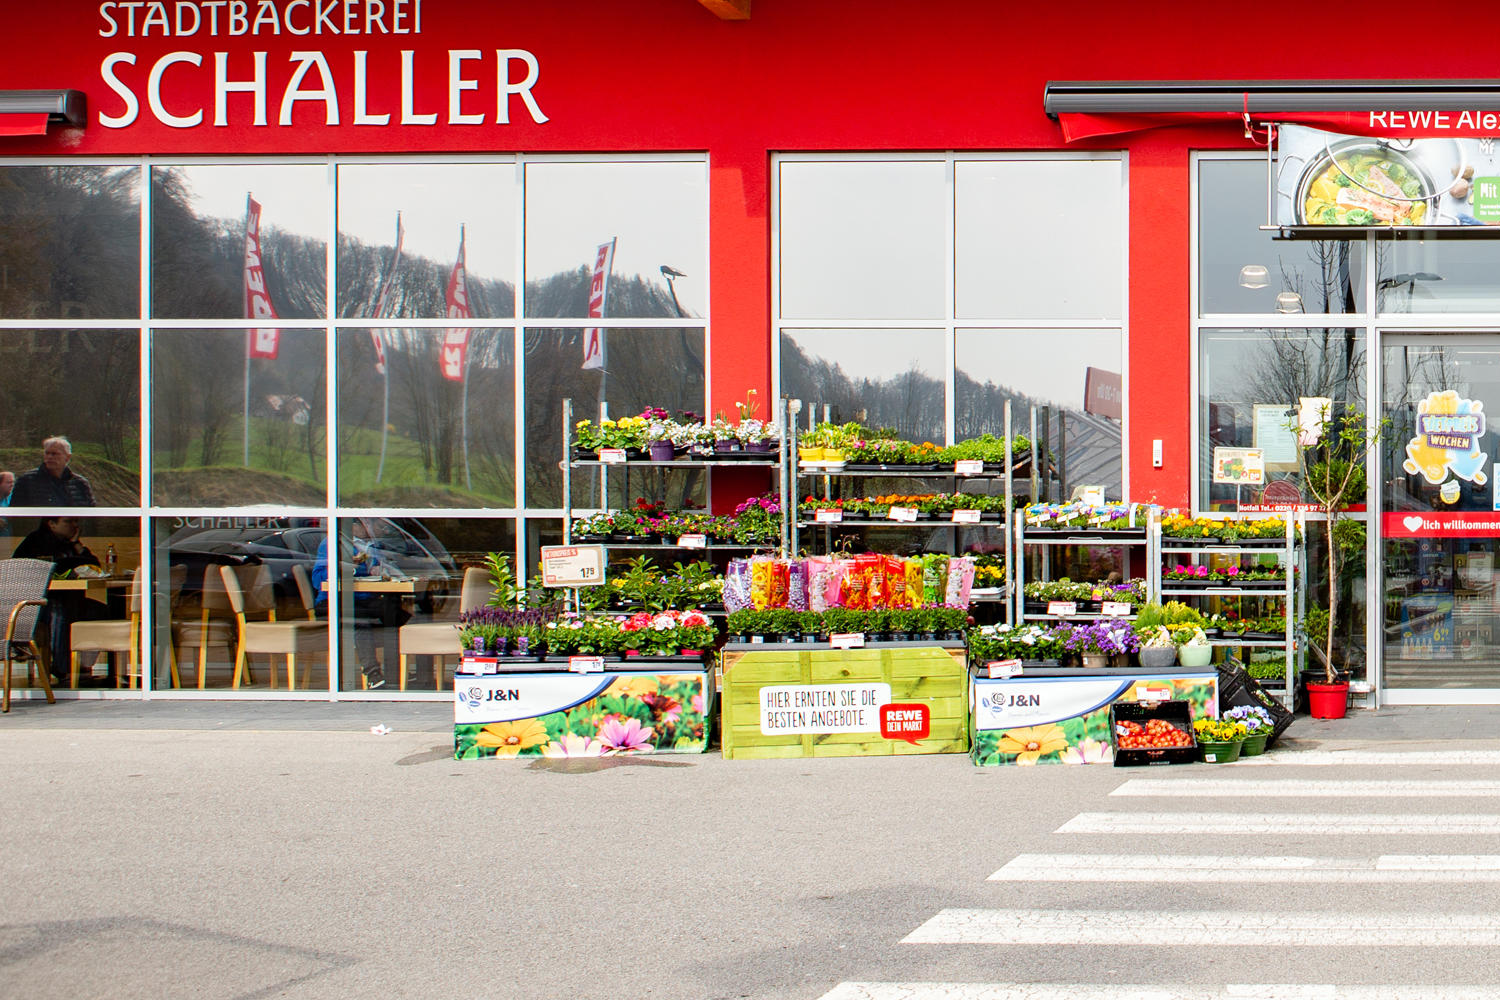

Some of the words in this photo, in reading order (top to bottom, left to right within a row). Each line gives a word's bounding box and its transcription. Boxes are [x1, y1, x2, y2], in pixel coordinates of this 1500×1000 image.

[98, 48, 550, 128] SCHALLER
[1369, 111, 1450, 128] REWE
[1480, 183, 1497, 199] Mit
[1431, 435, 1470, 449] WOCHEN
[174, 516, 280, 529] SCHALLER
[1423, 520, 1441, 529] lich
[486, 689, 520, 702] J&N
[766, 690, 791, 708] HIER
[795, 690, 838, 708] ERNTEN
[841, 689, 857, 706] SIE
[861, 688, 877, 706] DIE
[1007, 694, 1041, 708] J&N
[767, 711, 807, 728] BESTEN
[811, 709, 868, 728] ANGEBOTE.
[886, 709, 923, 722] REWE
[887, 721, 902, 733] DEIN
[902, 720, 923, 732] MARKT
